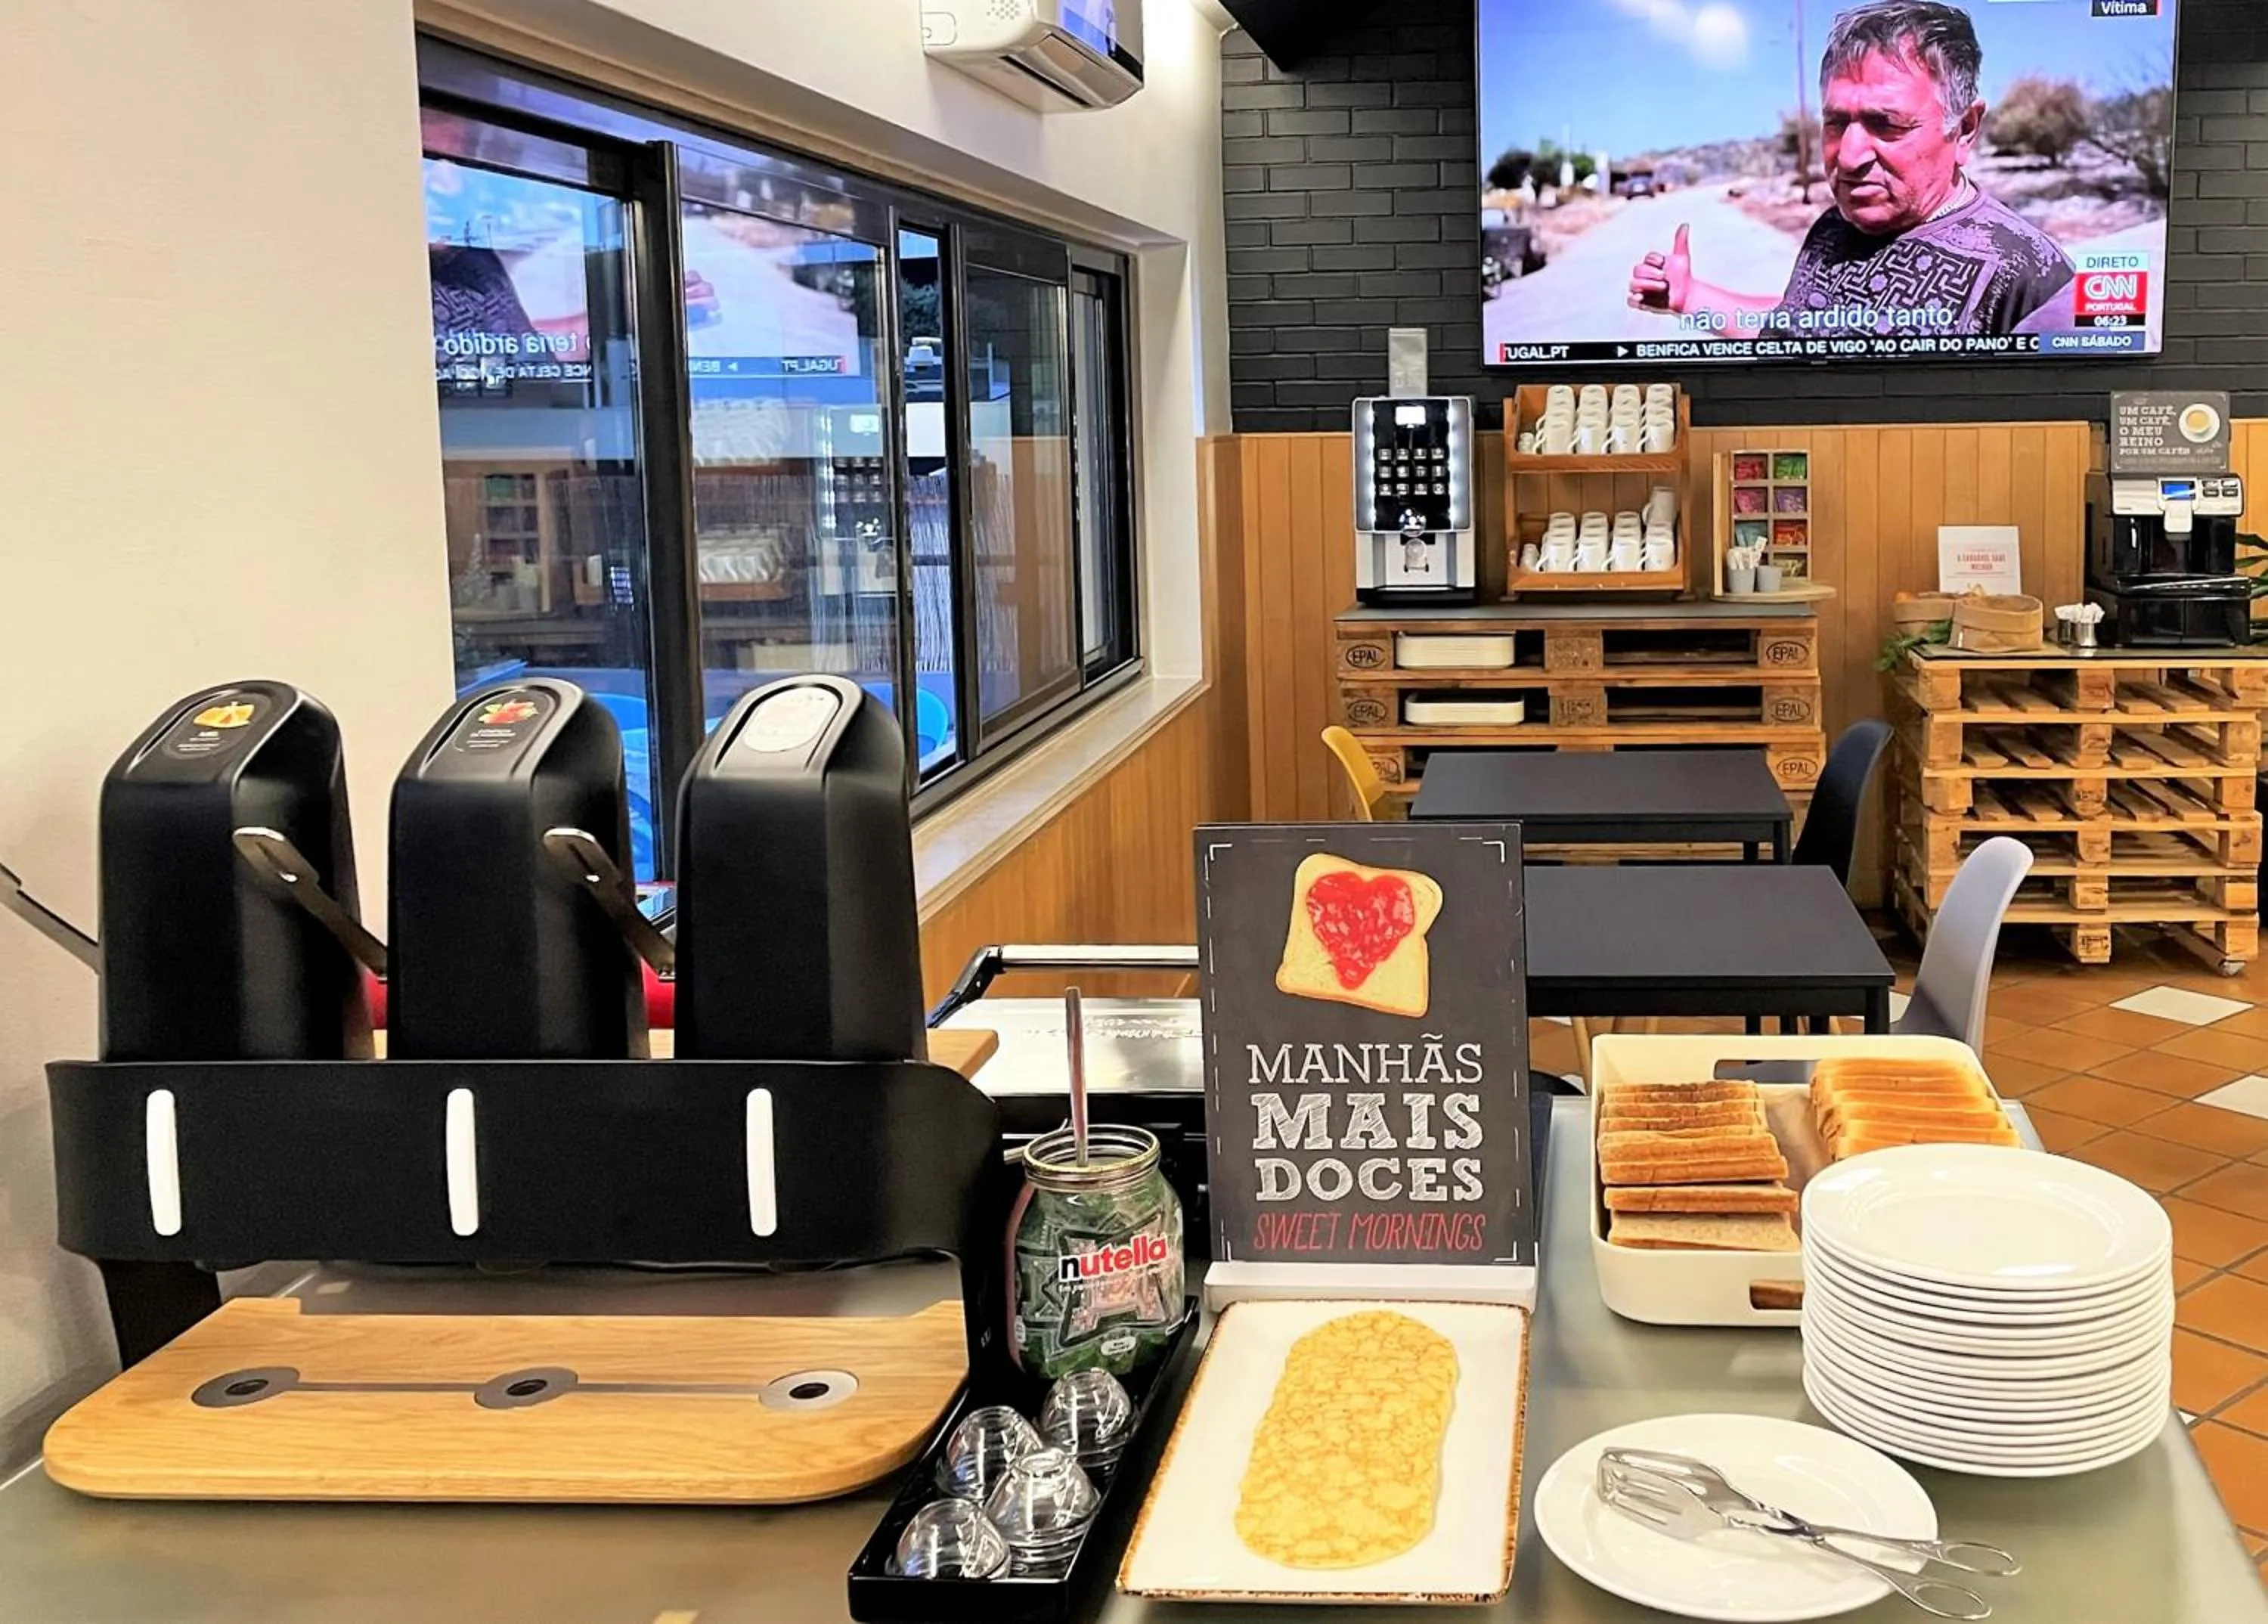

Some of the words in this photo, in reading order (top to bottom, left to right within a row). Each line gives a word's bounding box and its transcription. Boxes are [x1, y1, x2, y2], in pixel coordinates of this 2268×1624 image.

[2100, 1, 2147, 14] Vítima
[2086, 256, 2139, 268] DIRETO
[2084, 274, 2137, 300] CNN
[2085, 302, 2136, 311] PORTUGAL
[1680, 308, 1727, 330] não
[1734, 308, 1791, 330] teria
[1799, 304, 1879, 328] ardido
[1887, 305, 1959, 327] tanto.
[2094, 315, 2127, 327] 06:23
[1636, 342, 1700, 358] BENFICA
[1703, 342, 1752, 356] VENCE
[1755, 340, 1803, 355] CELTA
[1806, 340, 1827, 354] DE
[1830, 339, 1867, 353] VIGO
[1900, 339, 1936, 352] CAIR
[1939, 338, 1962, 352] DO
[2016, 336, 2027, 350] E
[2053, 336, 2078, 348] CNN
[2081, 333, 2132, 347] SÁBADO
[2119, 406, 2139, 415] UM
[2119, 417, 2137, 426] UM
[2119, 426, 2129, 436] O
[2132, 426, 2163, 436] MEU
[2119, 437, 2164, 446] REINO
[2141, 447, 2156, 455] UM
[1352, 649, 1378, 663] EPAL
[1773, 646, 1799, 659] EPAL
[1353, 705, 1380, 717] EPAL
[1777, 703, 1802, 716] EPAL
[1372, 761, 1395, 773] PAL
[1782, 762, 1811, 775] EPAL
[1246, 1034, 1483, 1084] MANHÃS
[1250, 1092, 1483, 1150] MAIS
[1254, 1158, 1484, 1201] DOCES
[1253, 1212, 1342, 1251] SWEET
[1349, 1212, 1486, 1251] MORNINGS
[1060, 1234, 1168, 1281] nutella
